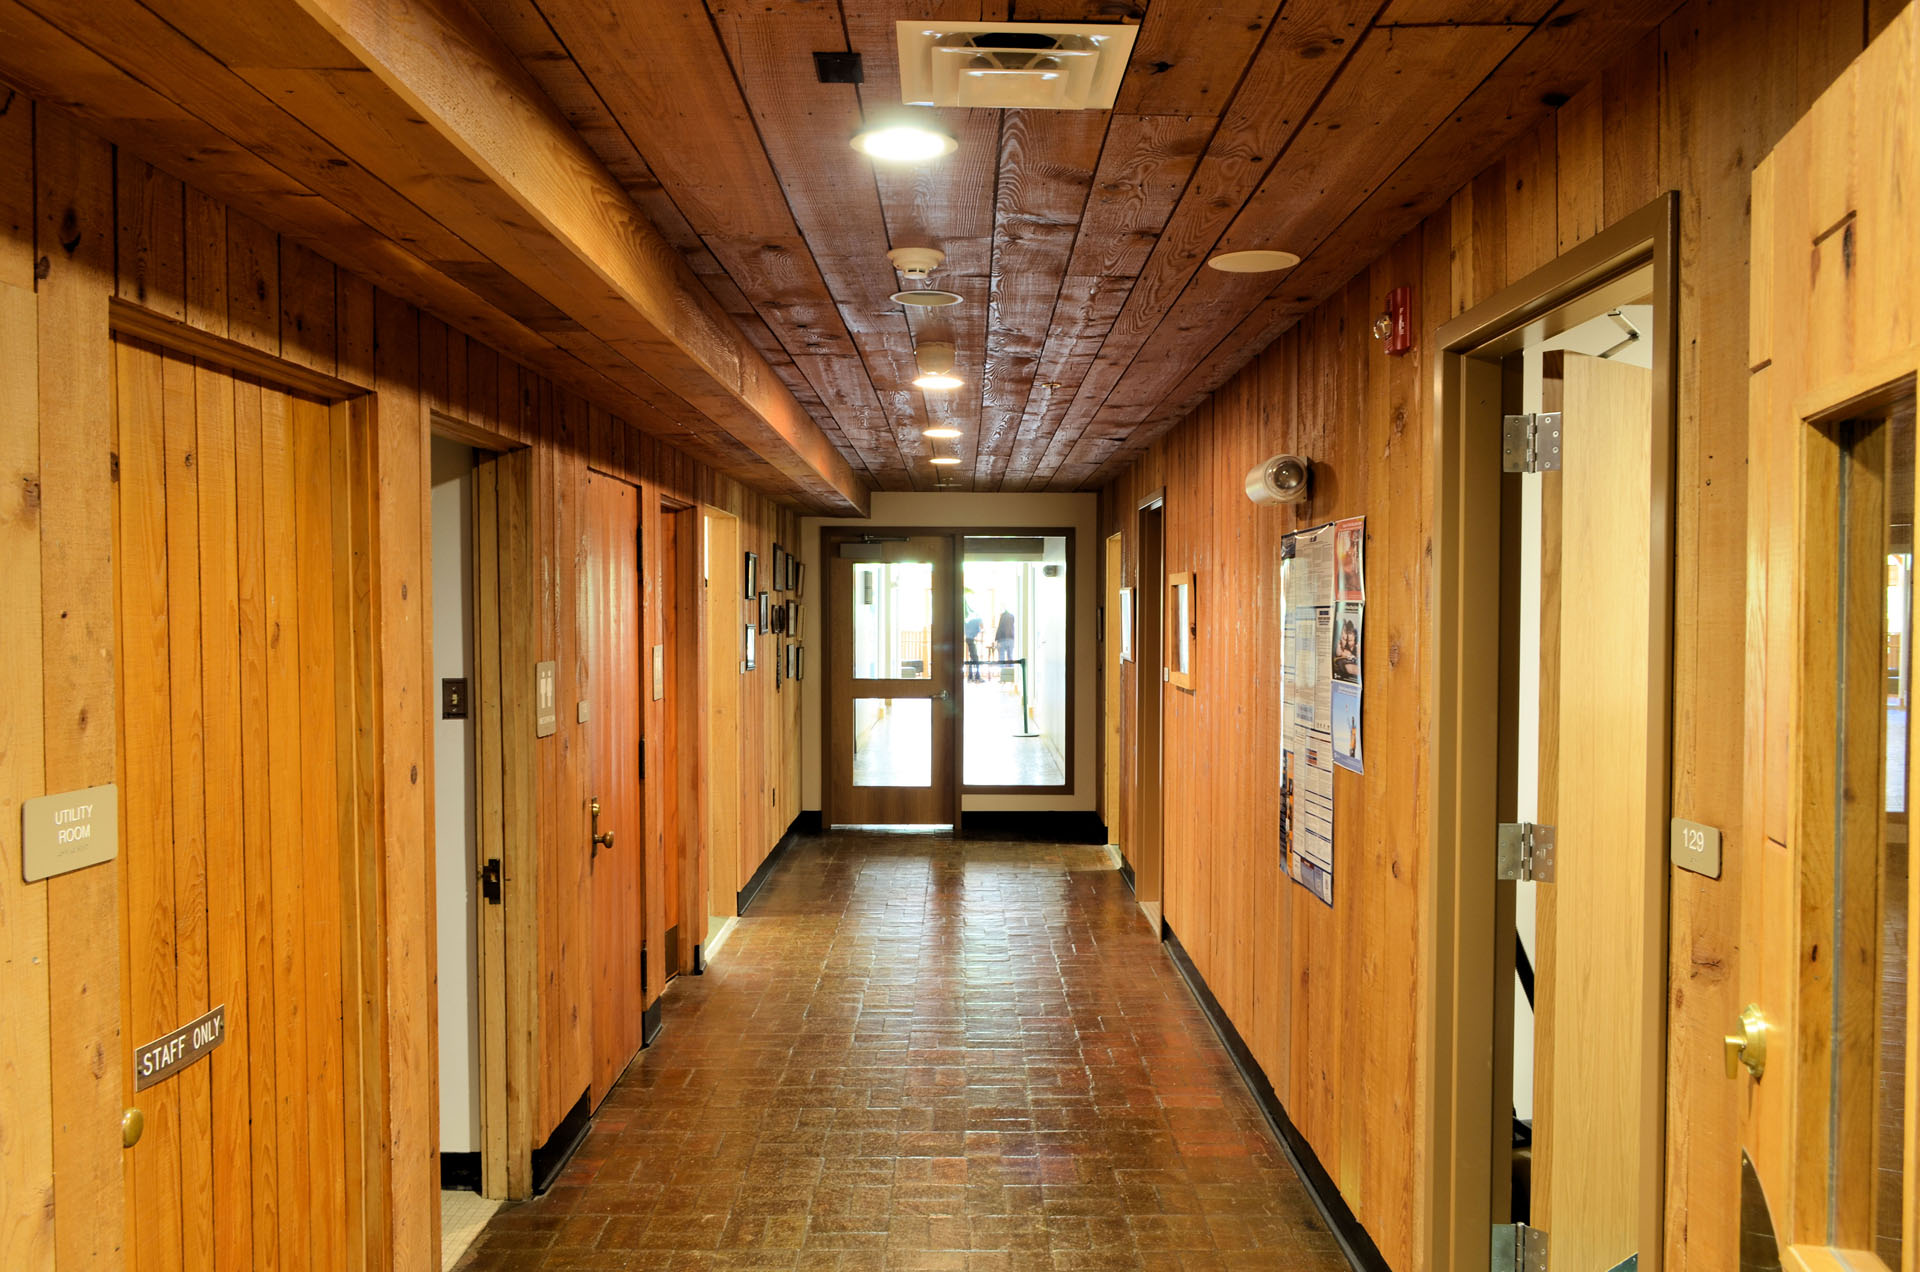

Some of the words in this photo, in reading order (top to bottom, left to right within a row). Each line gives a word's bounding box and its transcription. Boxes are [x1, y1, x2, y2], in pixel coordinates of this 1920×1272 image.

[55, 804, 93, 825] UTILITY
[58, 824, 91, 845] ROOM
[1682, 827, 1704, 852] 129
[143, 1034, 187, 1076] STAFF
[193, 1015, 221, 1050] ONLY
